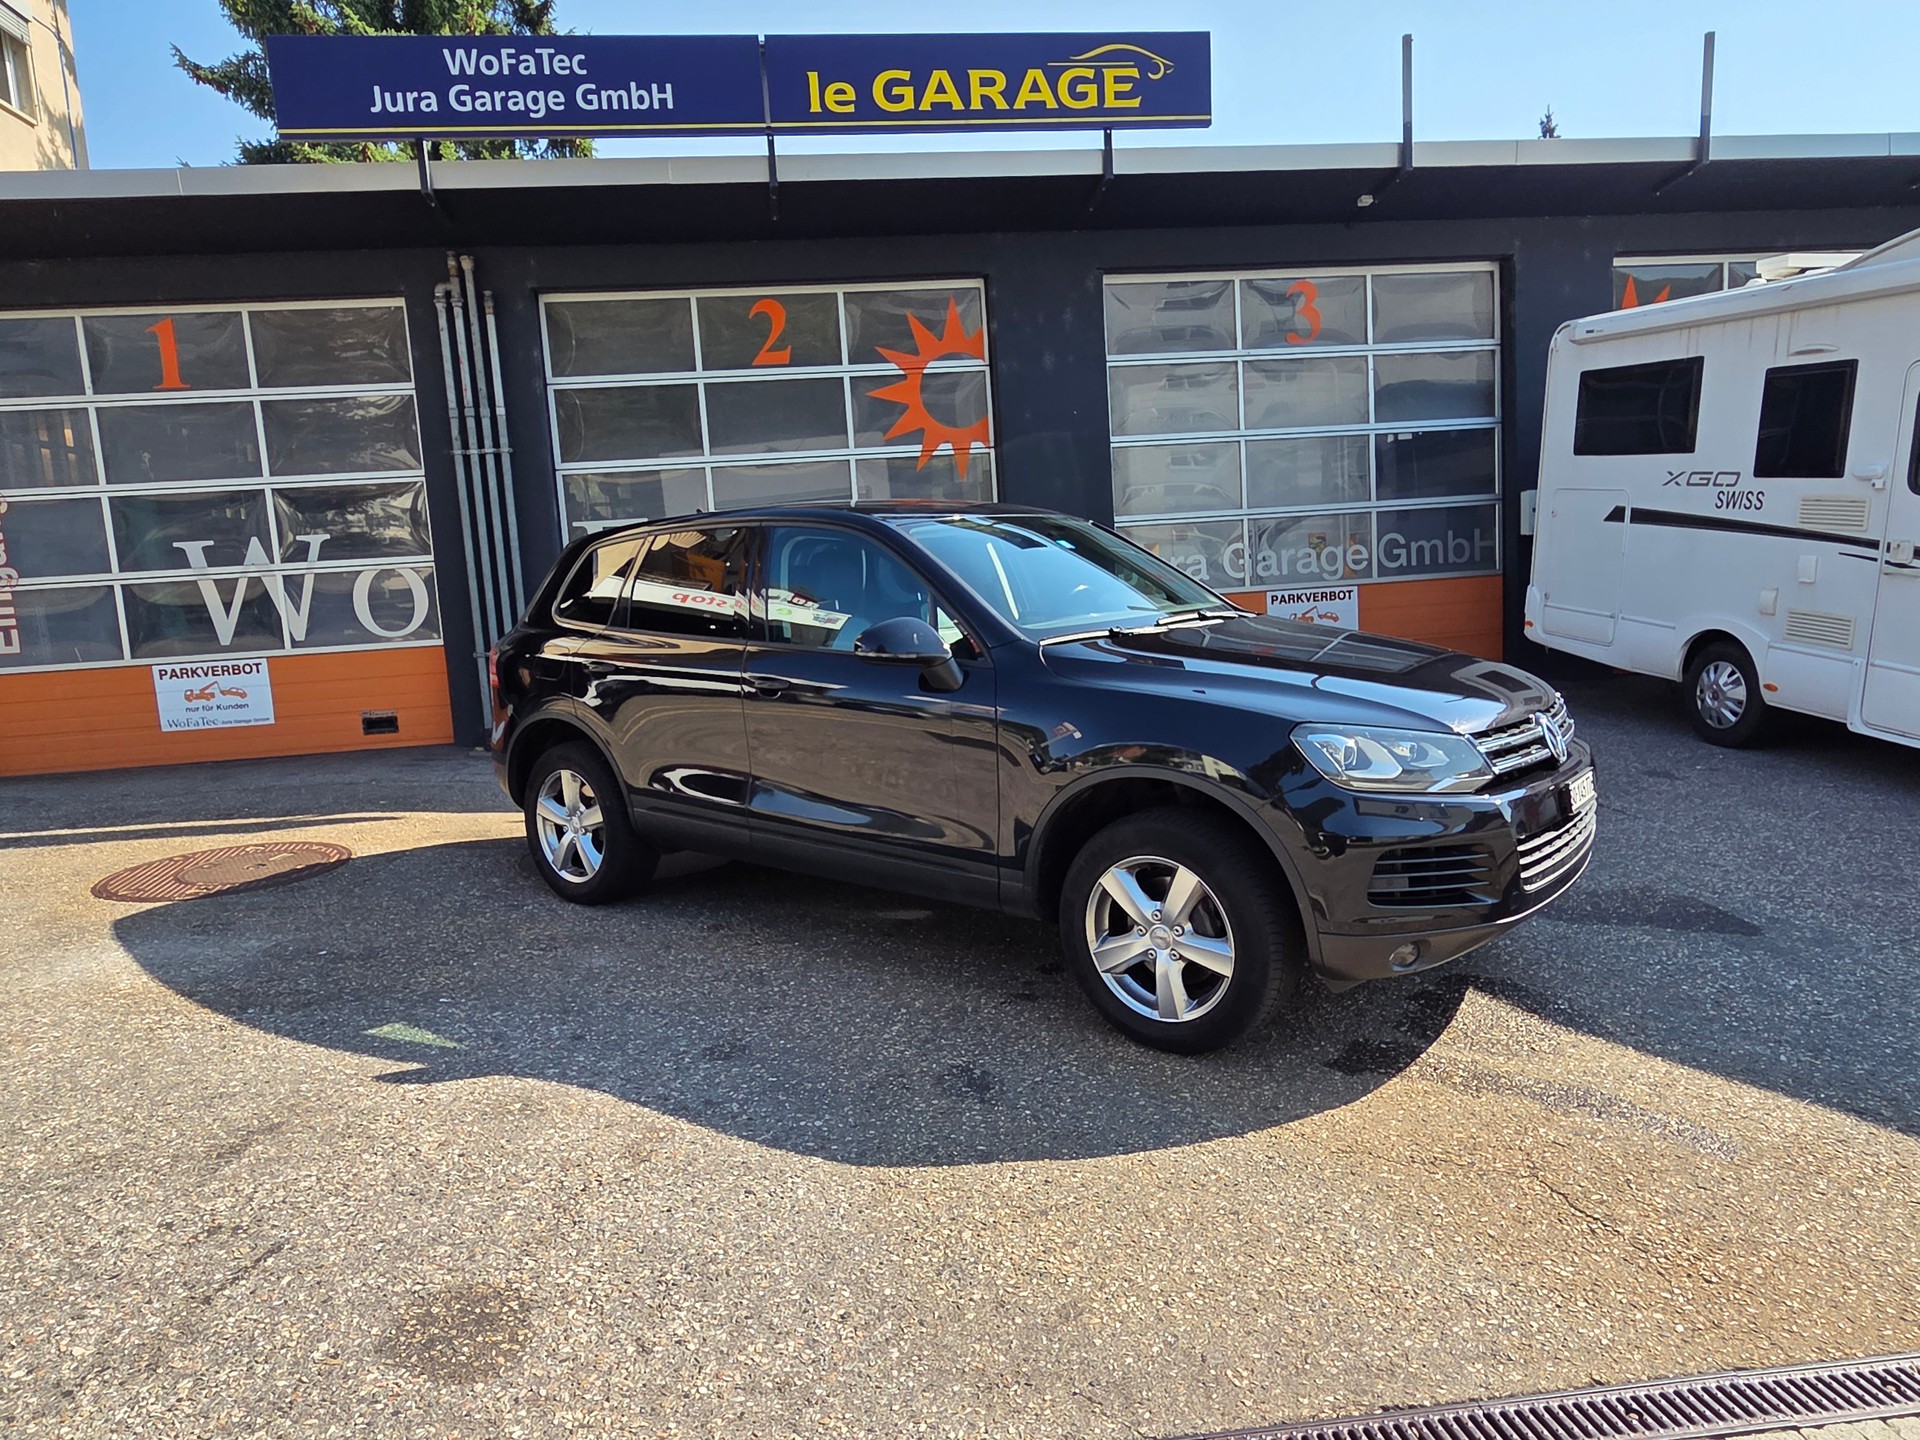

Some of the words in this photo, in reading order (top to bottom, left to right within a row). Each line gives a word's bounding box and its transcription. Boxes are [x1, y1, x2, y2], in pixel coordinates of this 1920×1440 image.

[443, 48, 587, 76] WoFaTec
[370, 86, 438, 113] Jura
[448, 84, 565, 119] Garage
[576, 81, 674, 110] GmbH
[806, 70, 857, 113] le
[872, 67, 1142, 112] GARAGE
[1285, 279, 1322, 345] 3
[747, 298, 792, 366] 2
[145, 317, 192, 391] 1
[1662, 470, 1741, 488] XGO
[1715, 490, 1766, 511] SWISS
[1222, 540, 1370, 581] Garage
[1377, 528, 1497, 569] GmbH
[1270, 590, 1354, 605] PARKVERBOT
[158, 662, 262, 680] PARKVERBOT
[202, 704, 214, 712] für
[216, 702, 250, 711] Kunden
[167, 716, 219, 729] WoFaTec
